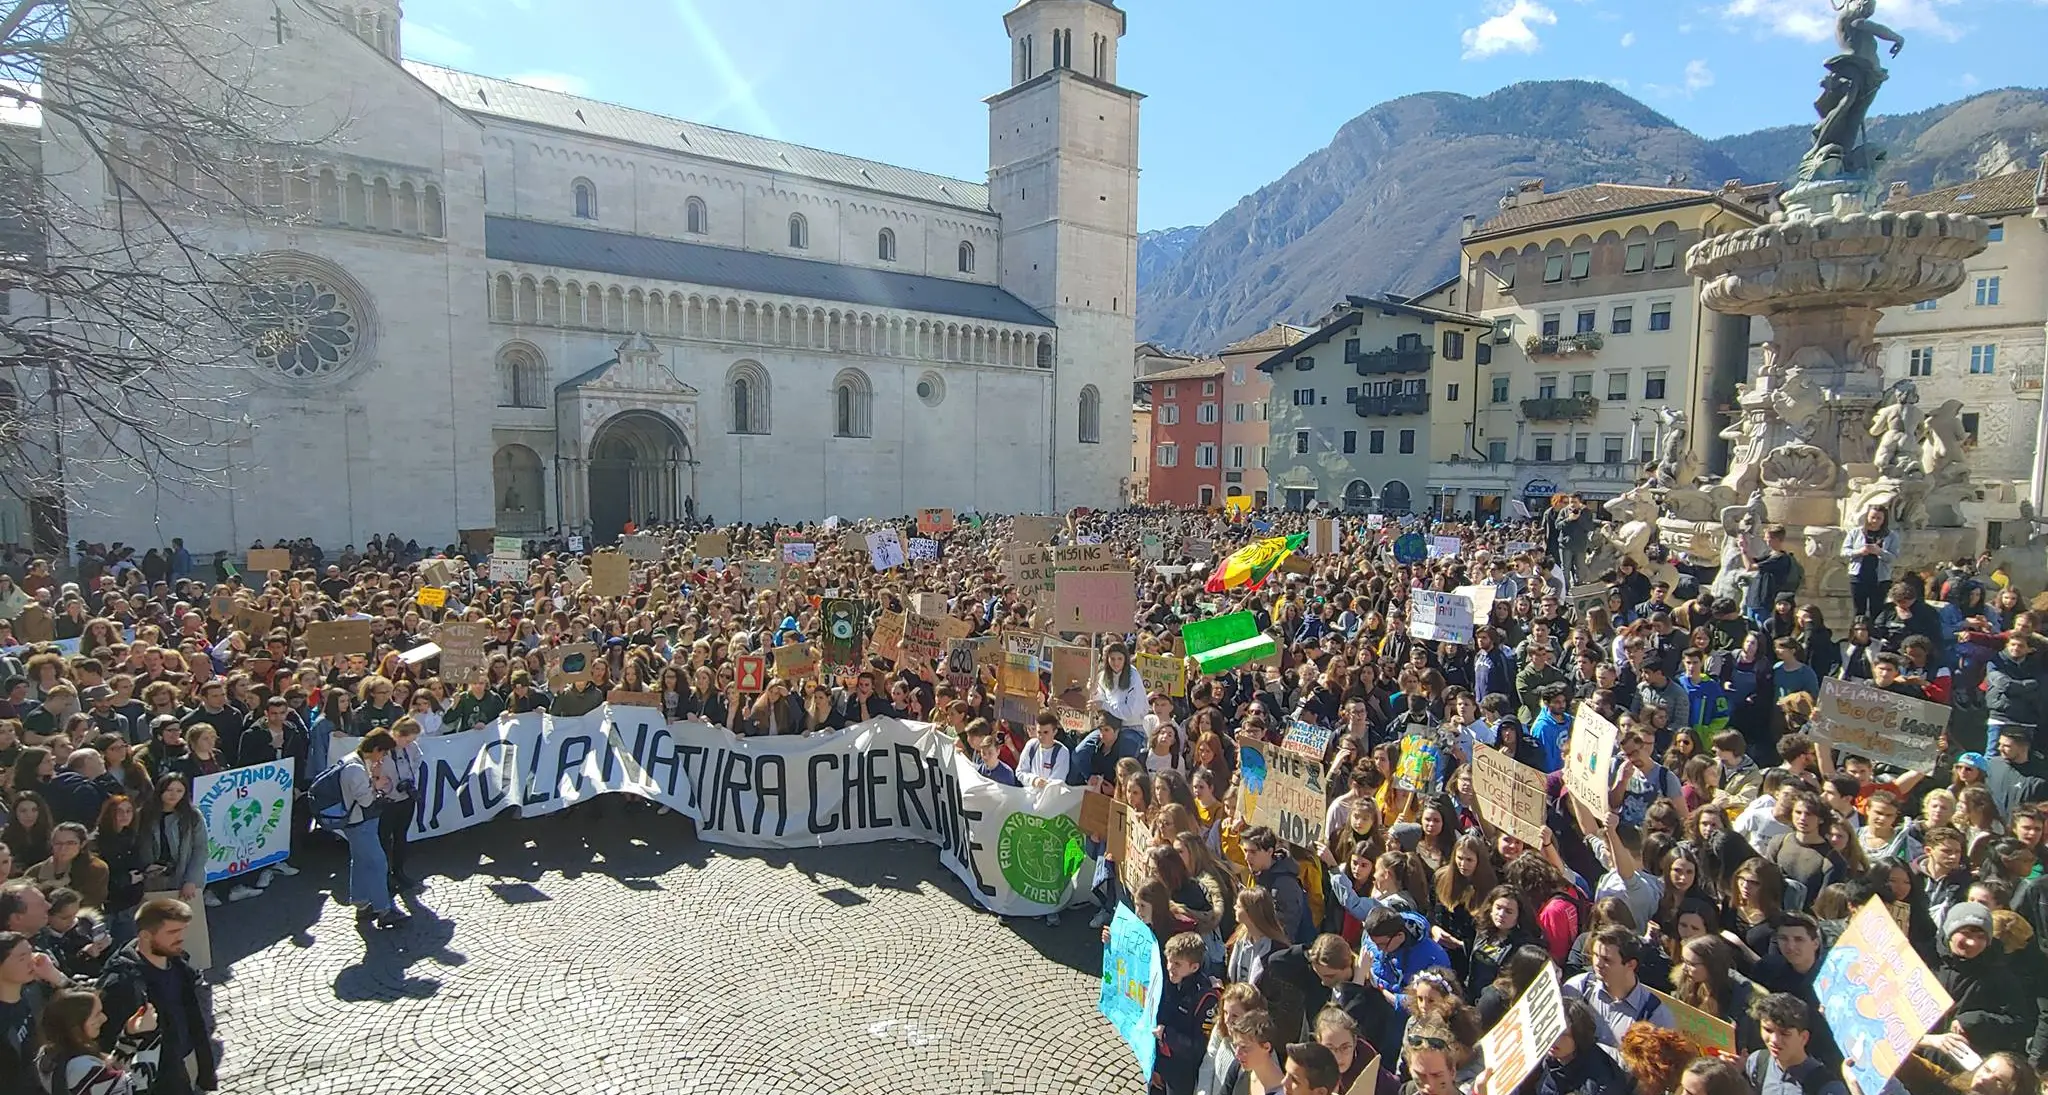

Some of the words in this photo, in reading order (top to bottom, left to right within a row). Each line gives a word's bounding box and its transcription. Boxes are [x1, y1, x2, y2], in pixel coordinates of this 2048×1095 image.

[1526, 483, 1558, 493] GROM
[1019, 553, 1037, 566] WE
[1055, 547, 1101, 561] MISSING
[1022, 569, 1042, 580] OUR
[1171, 660, 1182, 670] IS
[1825, 681, 1890, 702] ALZIAMO
[1836, 698, 1898, 729] VOCE
[1901, 717, 1943, 738] NON
[1268, 749, 1301, 779] THE
[1476, 754, 1534, 798] CHANGING
[220, 765, 276, 794] STAND
[274, 767, 293, 793] FOR
[236, 786, 248, 799] IS
[523, 728, 593, 804] LA
[602, 721, 788, 838] NATURA
[808, 749, 893, 835] CHE
[1275, 781, 1323, 820] FUTURE
[1482, 778, 1533, 816] TOGETHER
[1279, 809, 1322, 846] NOW
[228, 858, 251, 874] ON
[1117, 915, 1158, 965] THERE
[1906, 966, 1944, 1030] PRONTA
